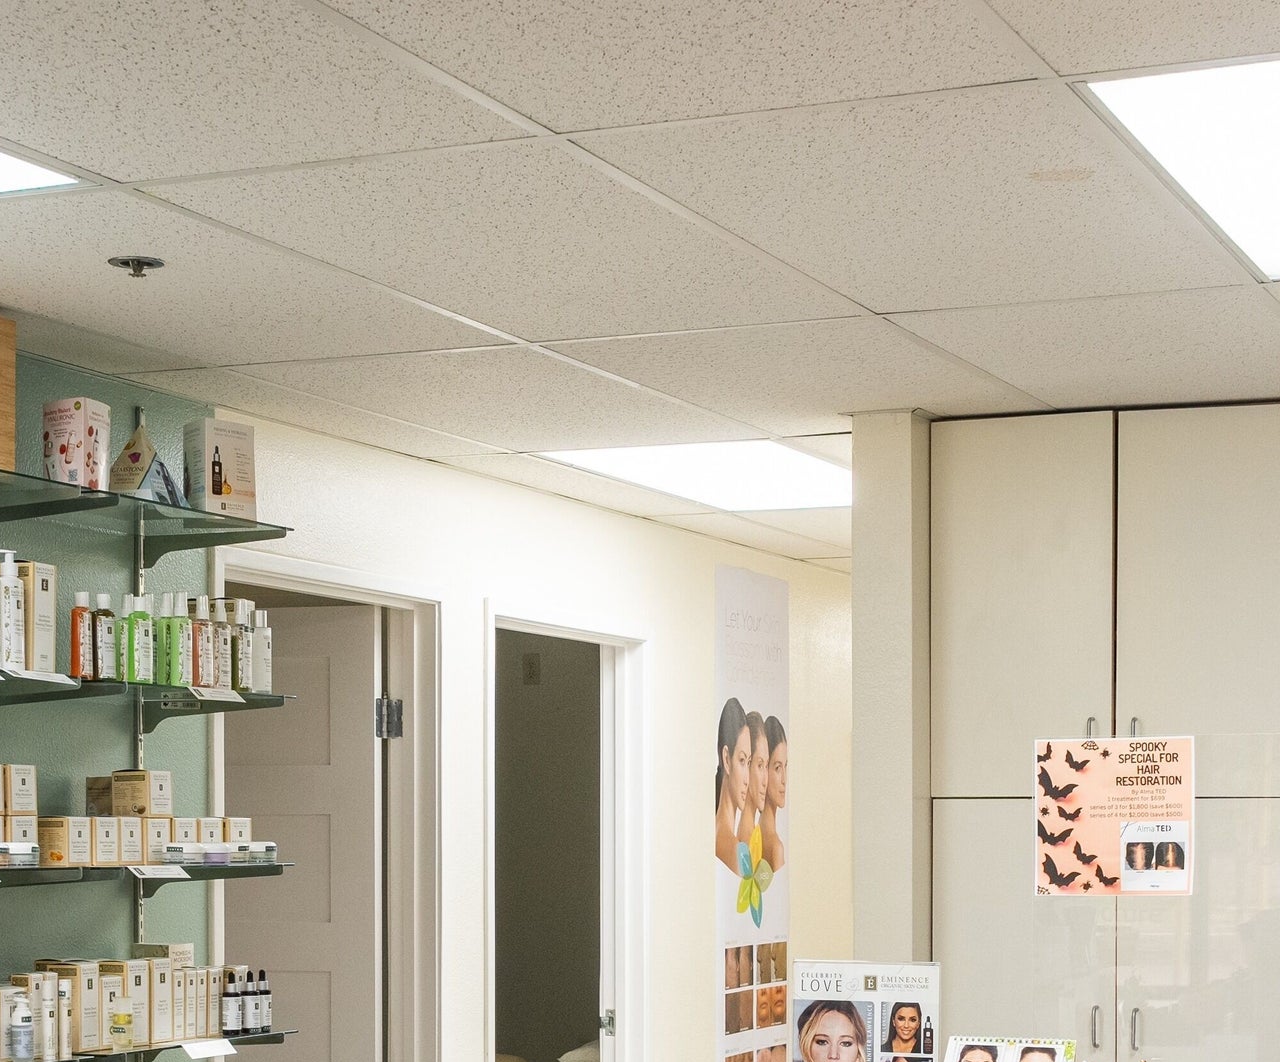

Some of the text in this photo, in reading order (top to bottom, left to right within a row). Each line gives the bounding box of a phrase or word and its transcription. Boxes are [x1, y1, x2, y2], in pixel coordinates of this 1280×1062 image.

[1129, 742, 1167, 752] SPOOKY
[1118, 752, 1179, 764] SPECIAL FOR
[1137, 764, 1160, 775] HAIR
[1116, 775, 1182, 787] RESTORATION
[1137, 825, 1155, 833] Alma
[801, 979, 842, 992] LOVE
[866, 1004, 874, 1037] LAWRENCE
